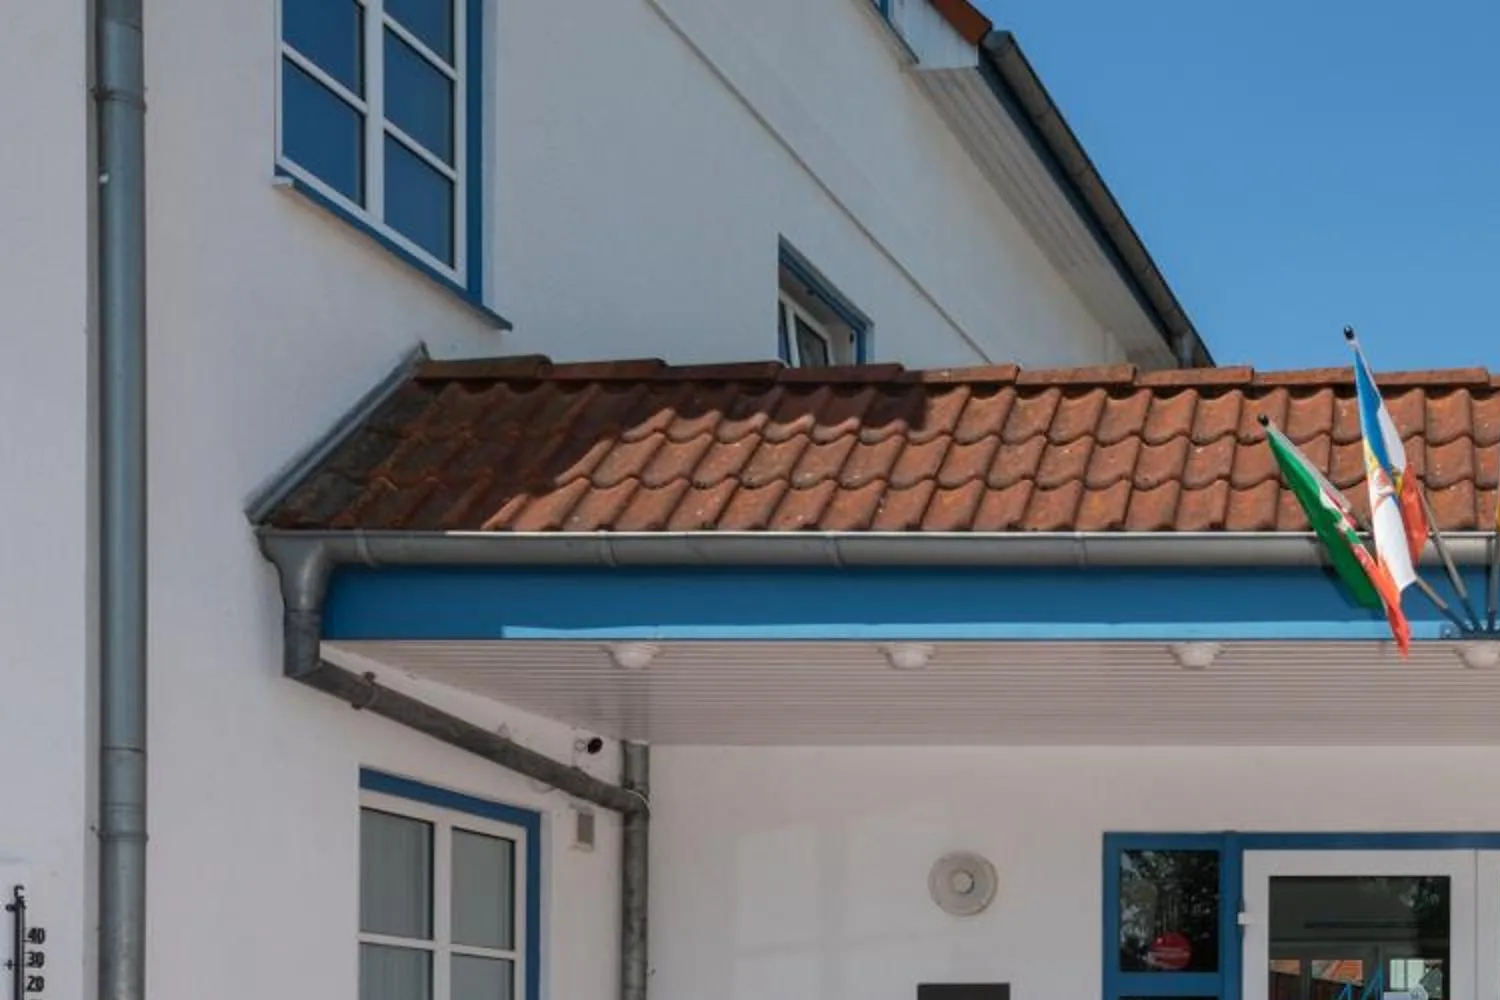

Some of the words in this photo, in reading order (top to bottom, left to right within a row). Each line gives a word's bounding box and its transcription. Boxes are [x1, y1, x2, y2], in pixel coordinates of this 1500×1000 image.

[27, 927, 46, 944] 40
[26, 951, 45, 968] 30
[27, 975, 45, 992] 20
